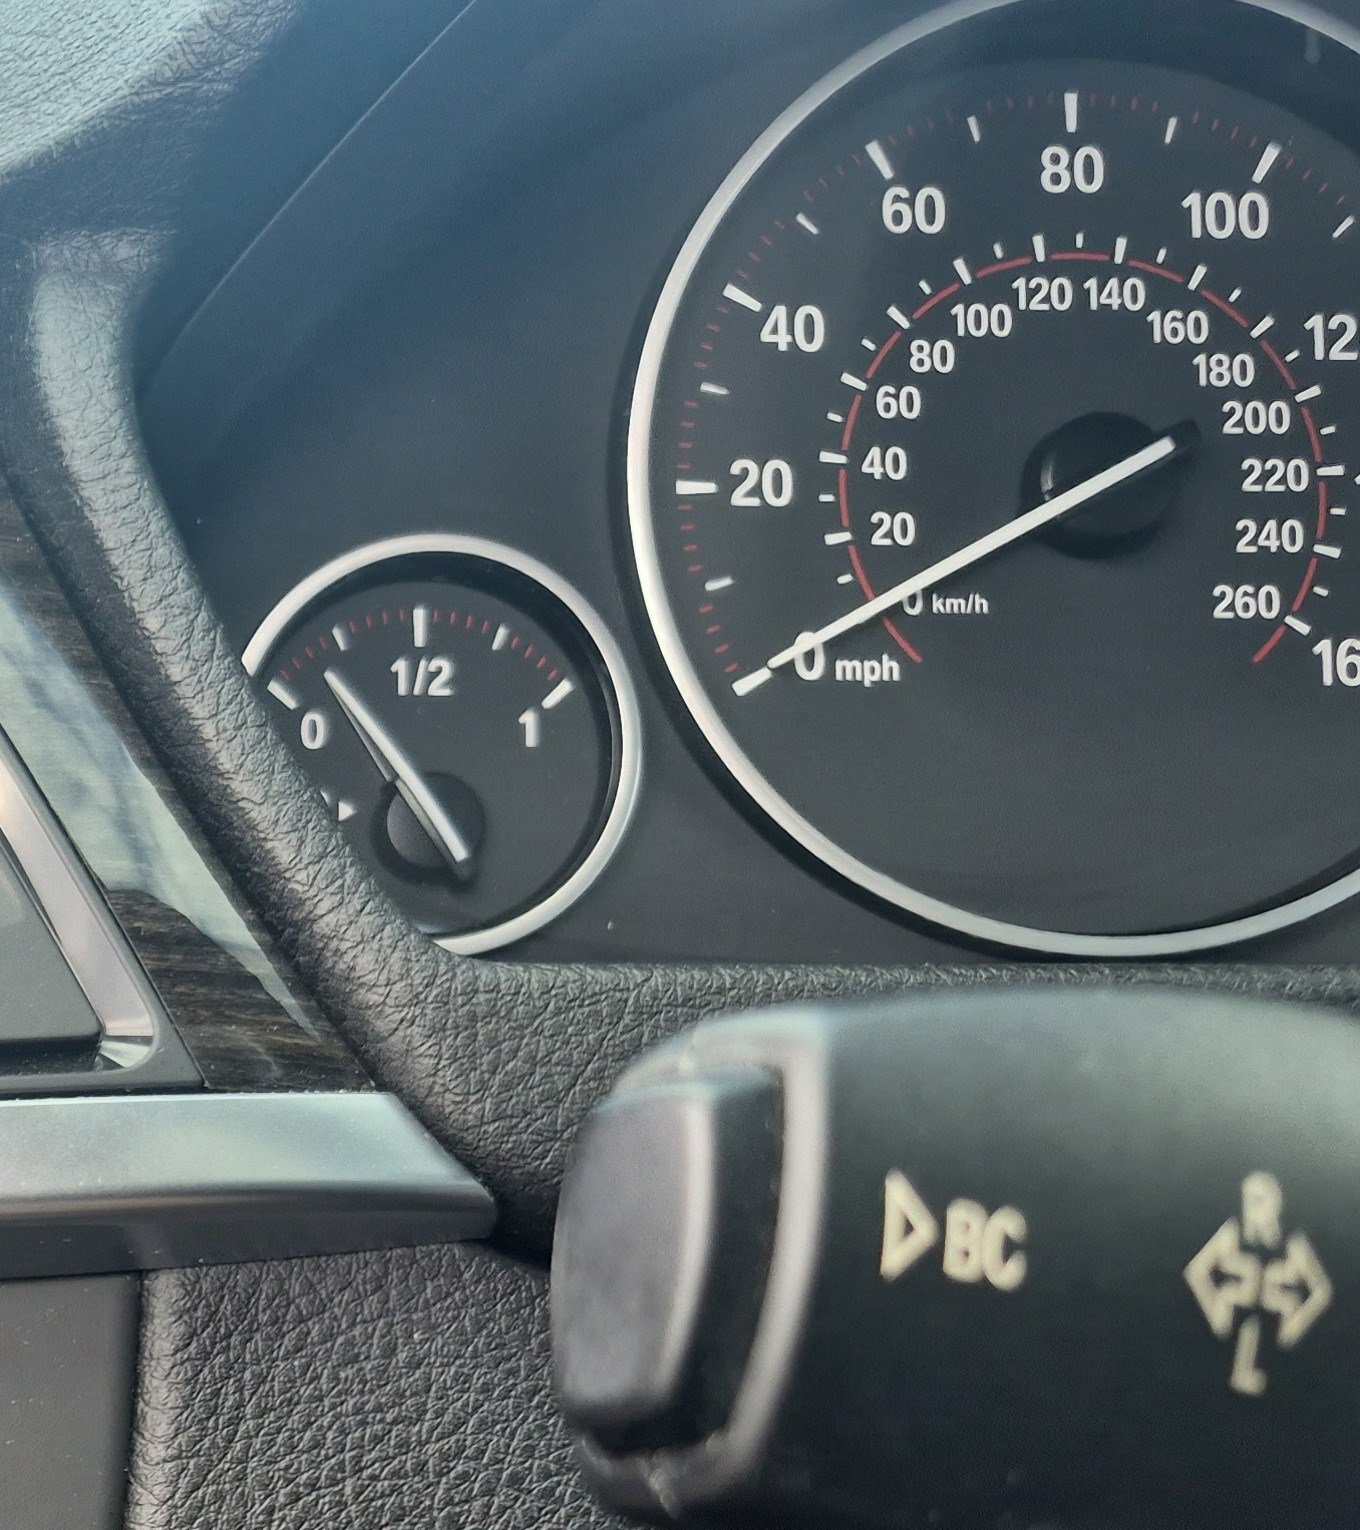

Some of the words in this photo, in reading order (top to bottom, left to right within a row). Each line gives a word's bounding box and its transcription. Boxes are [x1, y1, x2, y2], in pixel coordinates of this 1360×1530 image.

[1040, 146, 1104, 192] 80
[881, 186, 946, 234] 60
[1182, 192, 1270, 239] 100
[1011, 276, 1072, 311] 120
[1084, 275, 1146, 311] 140
[761, 305, 825, 352] 40
[950, 302, 1011, 338] 100
[1146, 310, 1209, 345] 160
[909, 338, 955, 374] 80
[1192, 354, 1254, 386] 180
[876, 385, 921, 419] 60
[1222, 401, 1290, 434] 200
[861, 446, 907, 480] 40
[1241, 458, 1309, 492] 220
[729, 459, 793, 508] 20
[870, 511, 916, 546] 20
[1235, 519, 1304, 553] 240
[932, 591, 989, 615] km/h
[1212, 586, 1280, 619] 260
[390, 657, 454, 697] 1/2
[835, 652, 900, 687] mph
[300, 712, 327, 749] 0
[518, 709, 539, 747] 1
[1241, 1170, 1282, 1248] R
[943, 1198, 1027, 1291] BC
[1229, 1315, 1268, 1395] L
